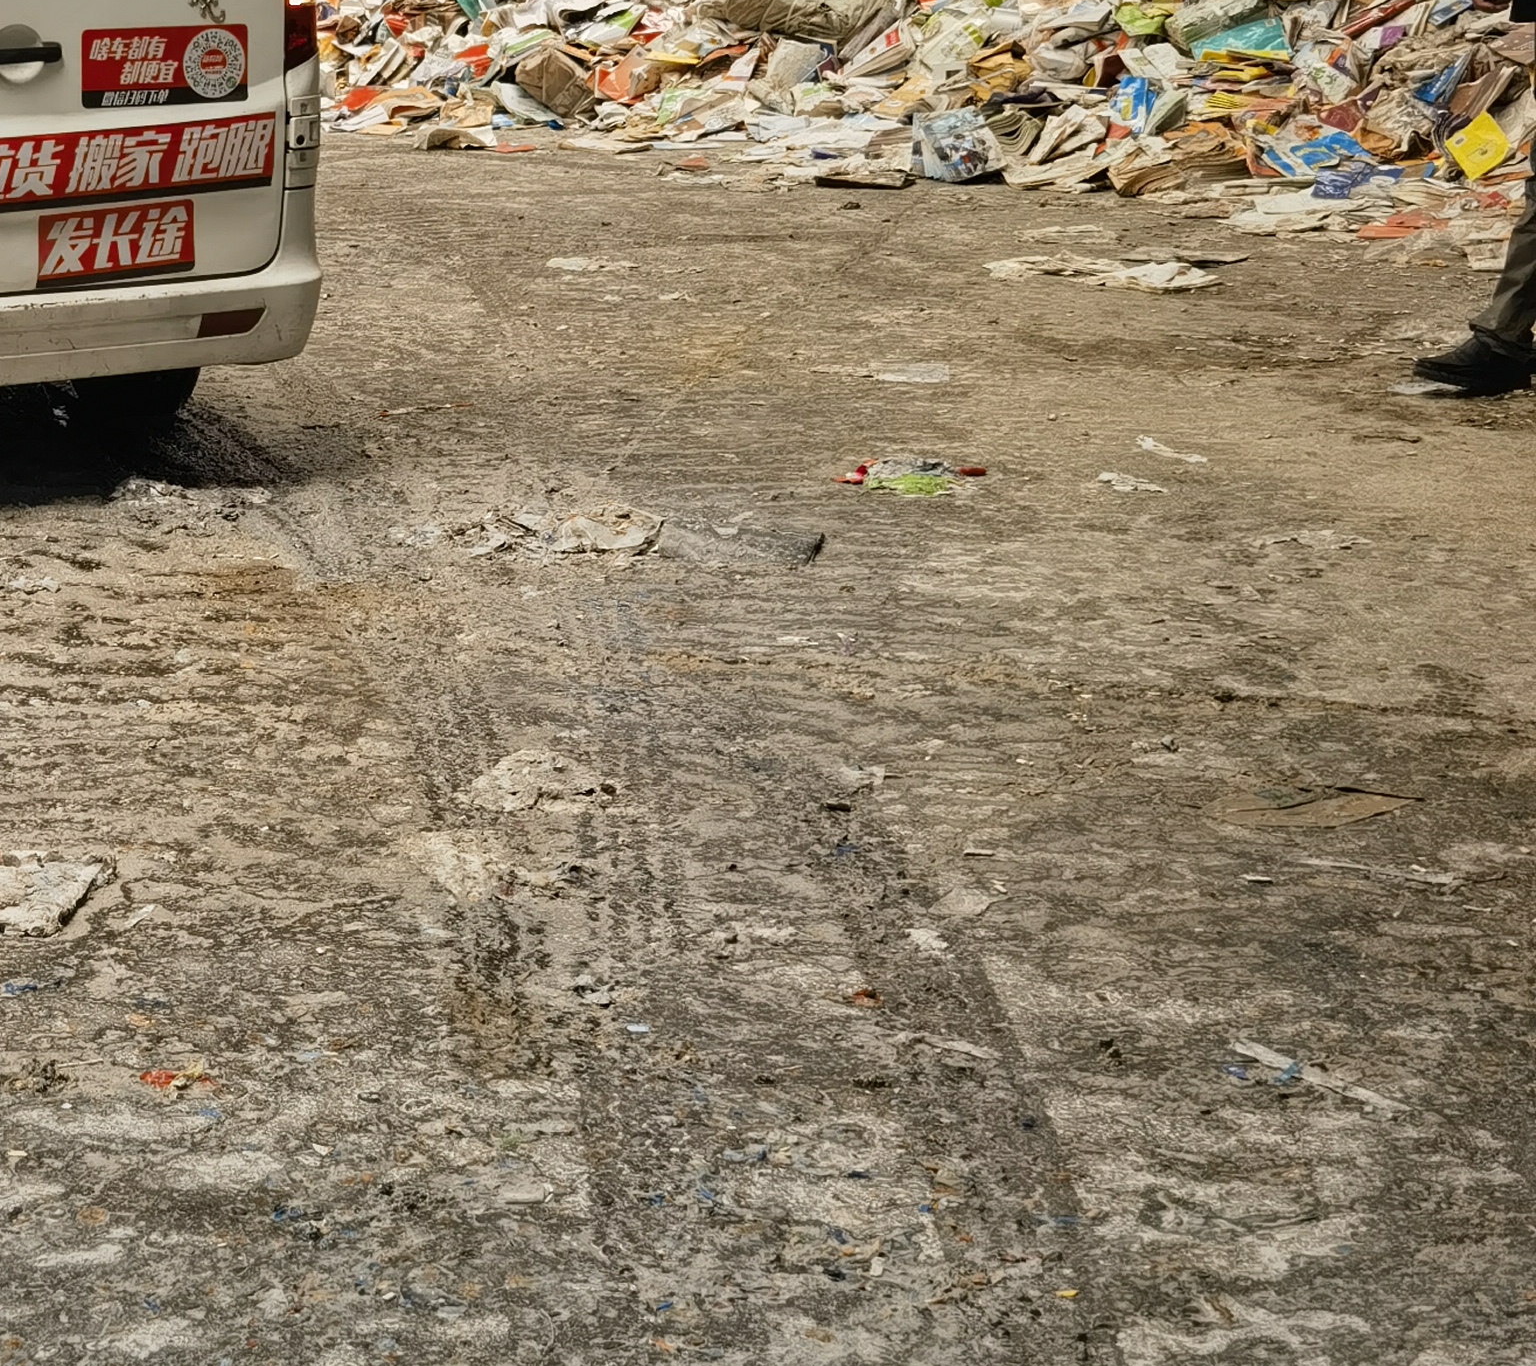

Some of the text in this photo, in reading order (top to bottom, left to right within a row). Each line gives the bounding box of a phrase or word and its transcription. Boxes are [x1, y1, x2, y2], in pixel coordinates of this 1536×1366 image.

[88, 35, 168, 61] 啥车都有
[119, 59, 179, 85] 都便宜
[100, 88, 170, 107] 微信扫码下单
[65, 130, 172, 194] 搬家
[171, 117, 275, 183] 跑腿
[38, 205, 189, 276] 发长途
